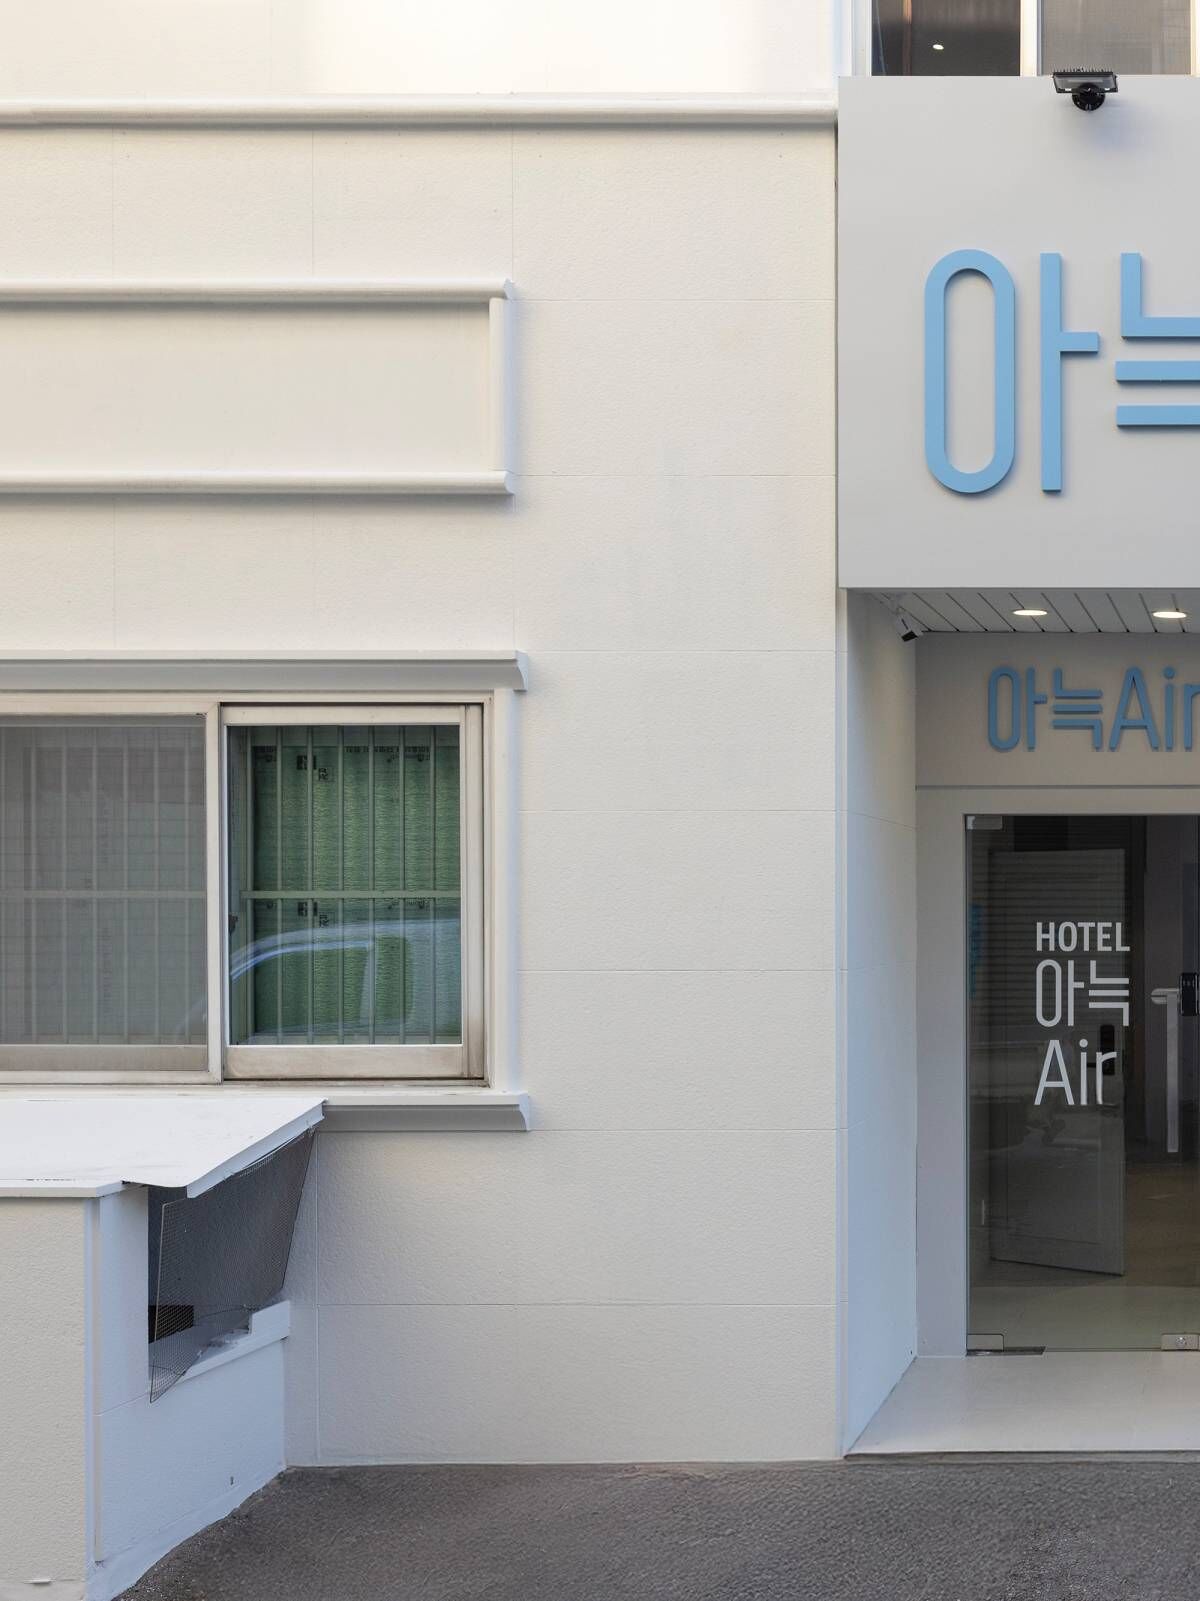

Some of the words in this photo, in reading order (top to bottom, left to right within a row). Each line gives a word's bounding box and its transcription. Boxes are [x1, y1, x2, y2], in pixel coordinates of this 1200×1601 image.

[1036, 921, 1130, 952] HOTEL
[1036, 959, 1130, 1027] 아늑
[1034, 1038, 1117, 1106] Air
